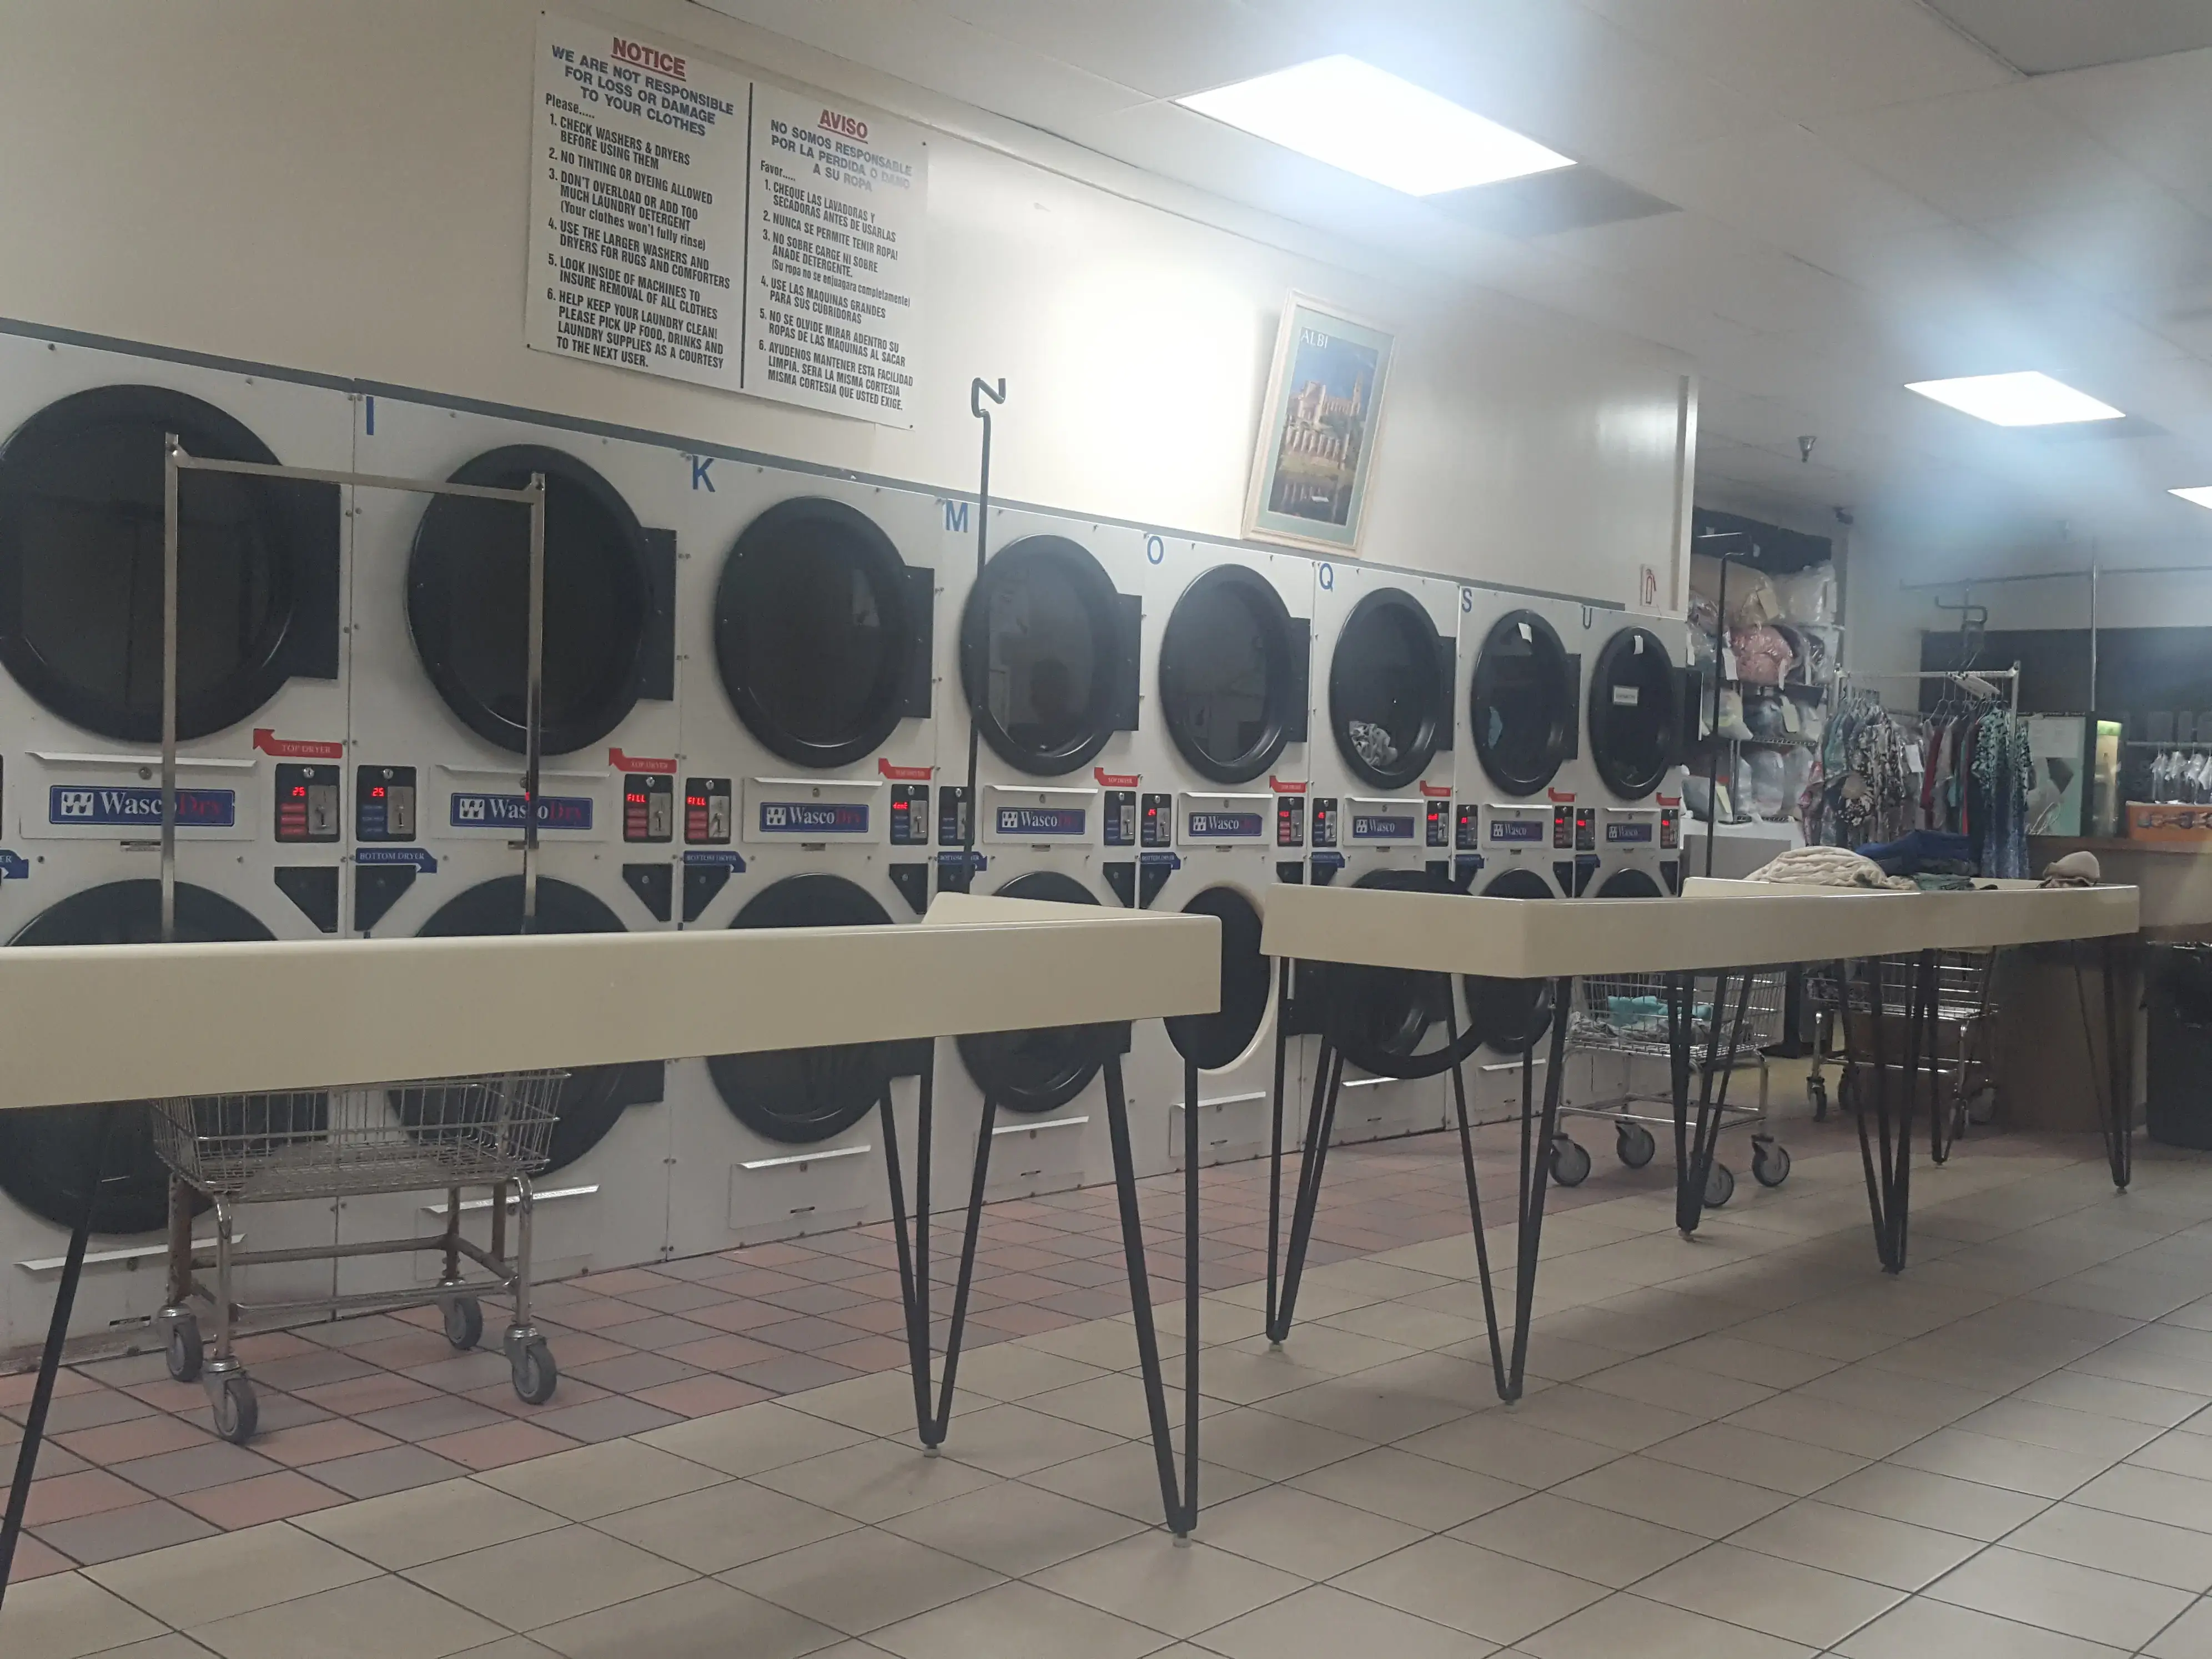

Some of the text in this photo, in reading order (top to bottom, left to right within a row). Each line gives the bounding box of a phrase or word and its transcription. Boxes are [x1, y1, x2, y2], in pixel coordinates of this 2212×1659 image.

[614, 37, 685, 77] NOTICE
[552, 46, 733, 115] WE ARE NOT RESPONSIBLE
[565, 66, 715, 124] FOR LOSS OR DAMAGE
[581, 87, 706, 135] TO YOUR CLOTHES
[820, 109, 868, 139] AVISO
[561, 117, 690, 165] CHECK WASHERS & DRYERS
[561, 130, 659, 169] BEFORE USING THEM
[771, 120, 787, 134] NO
[792, 127, 831, 149] SOMOS
[561, 150, 712, 204] NO TINTING OR DYEING ALLOWED
[819, 150, 866, 175] PERDIDA
[825, 168, 839, 181] SU
[561, 185, 690, 232] MUCH LAUNDRY DETERGENT
[593, 180, 697, 220] OVERLOAD OR ADD TOO
[773, 182, 867, 220] CHEQUE LAS LAVADORAS
[773, 194, 896, 242] SECADORAS ANTES USARLAS
[560, 220, 709, 270] USE THE LARGER WASHERS AND
[590, 210, 706, 250] clothes fully rinse)
[773, 213, 849, 246] NUNCA PERMITE
[560, 234, 730, 289] DRYERS FOR RUGS AND COMFORTERS
[787, 236, 878, 273] SOBRE CARGE SOBRE
[560, 270, 718, 320] INSURE REMOVAL OF ALL CLOTHES
[561, 257, 700, 302] LOOK INSIDE OF MACHINES TO
[771, 278, 886, 318] USE LAS MAQUINAS GRANDES
[823, 273, 856, 292] enjuagara
[560, 290, 683, 331] HELP KEEP YOUR LAUNDRY
[770, 290, 810, 310] PARA SUS
[558, 321, 723, 368] LAUNDRY SUPPLIES AS A COURTESY
[559, 306, 723, 354] PLEASE PICK UP DRINKS AND
[770, 323, 905, 367] ROPAS LAS MAQUINAS AL SACAR
[796, 317, 887, 349] OLVIDE MIRAR ADENTRO
[1301, 329, 1328, 349] ALBI
[557, 336, 648, 367] TO THE NEXT USER.
[769, 342, 913, 386] AYUDENOS MANTENER ESTA FACILIDAD
[768, 369, 878, 405] MISMA CORTESIA QUE USTED
[769, 356, 899, 396] LIMPIA. SERA LA MISMA CORTESIA
[693, 455, 716, 492] K
[946, 502, 968, 533] M
[1147, 535, 1164, 565] O
[1319, 563, 1334, 590] Q
[1462, 588, 1472, 612] S
[1582, 607, 1592, 629] U
[282, 744, 331, 753] TOP DRYER
[293, 787, 305, 796] 25
[372, 787, 384, 797] 25
[627, 793, 646, 802] FILL
